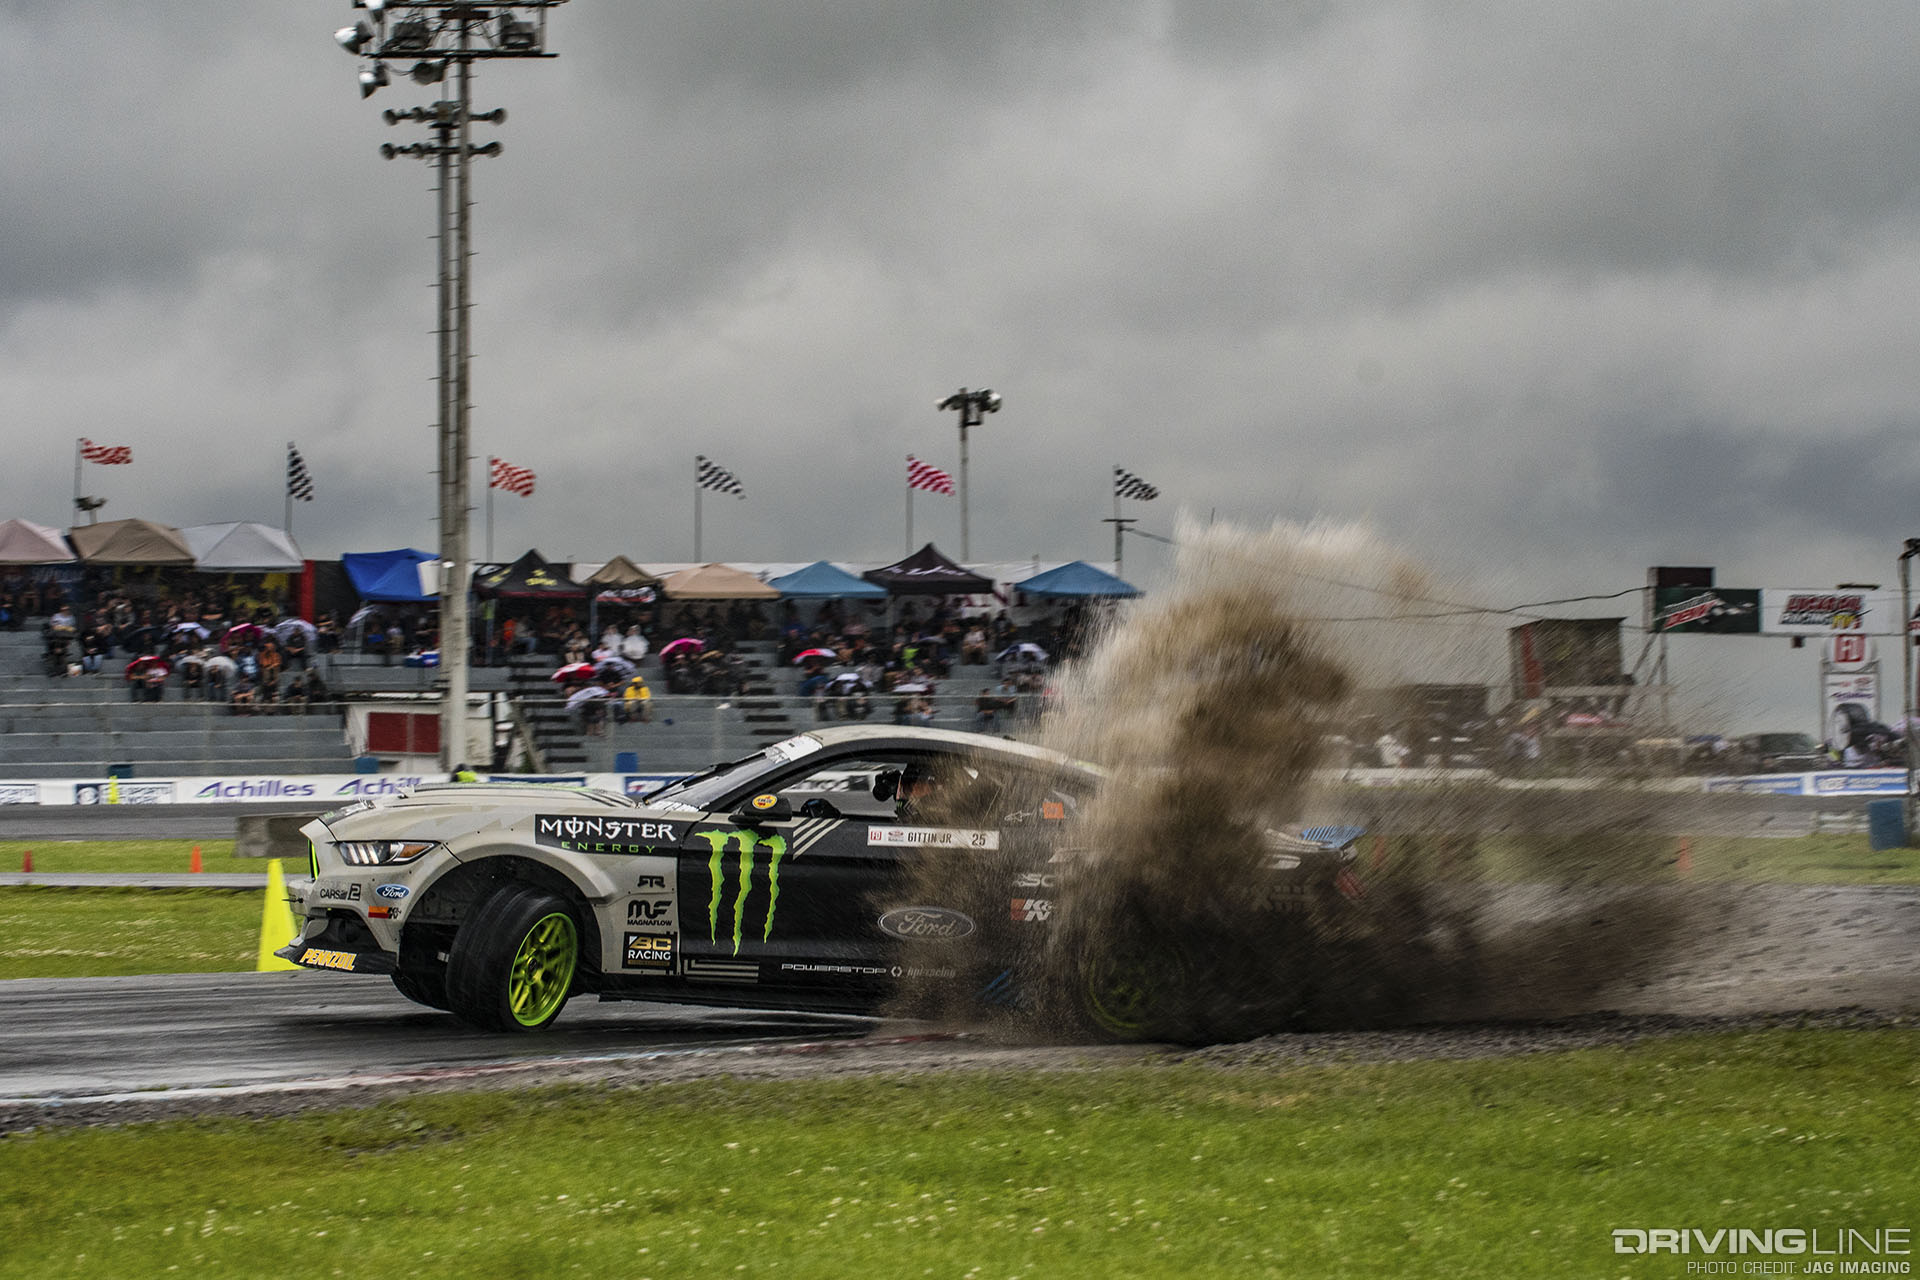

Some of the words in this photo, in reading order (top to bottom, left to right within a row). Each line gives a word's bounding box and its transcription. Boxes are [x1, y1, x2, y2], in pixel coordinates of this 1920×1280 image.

[196, 780, 315, 798] Achilles
[540, 817, 677, 842] MONSTER
[907, 832, 938, 843] GITTIN
[939, 833, 952, 843] JR
[971, 833, 987, 846] 25
[561, 841, 656, 853] ENERGY
[319, 888, 341, 899] CARS
[349, 884, 361, 900] 2
[382, 886, 406, 898] Ford
[627, 919, 673, 927] MAGNAFLOW
[898, 911, 957, 936] Ford
[629, 936, 672, 951] BC
[299, 948, 357, 971] PENNZOIL
[628, 950, 672, 961] RACING
[781, 963, 887, 974] POWERSTOP
